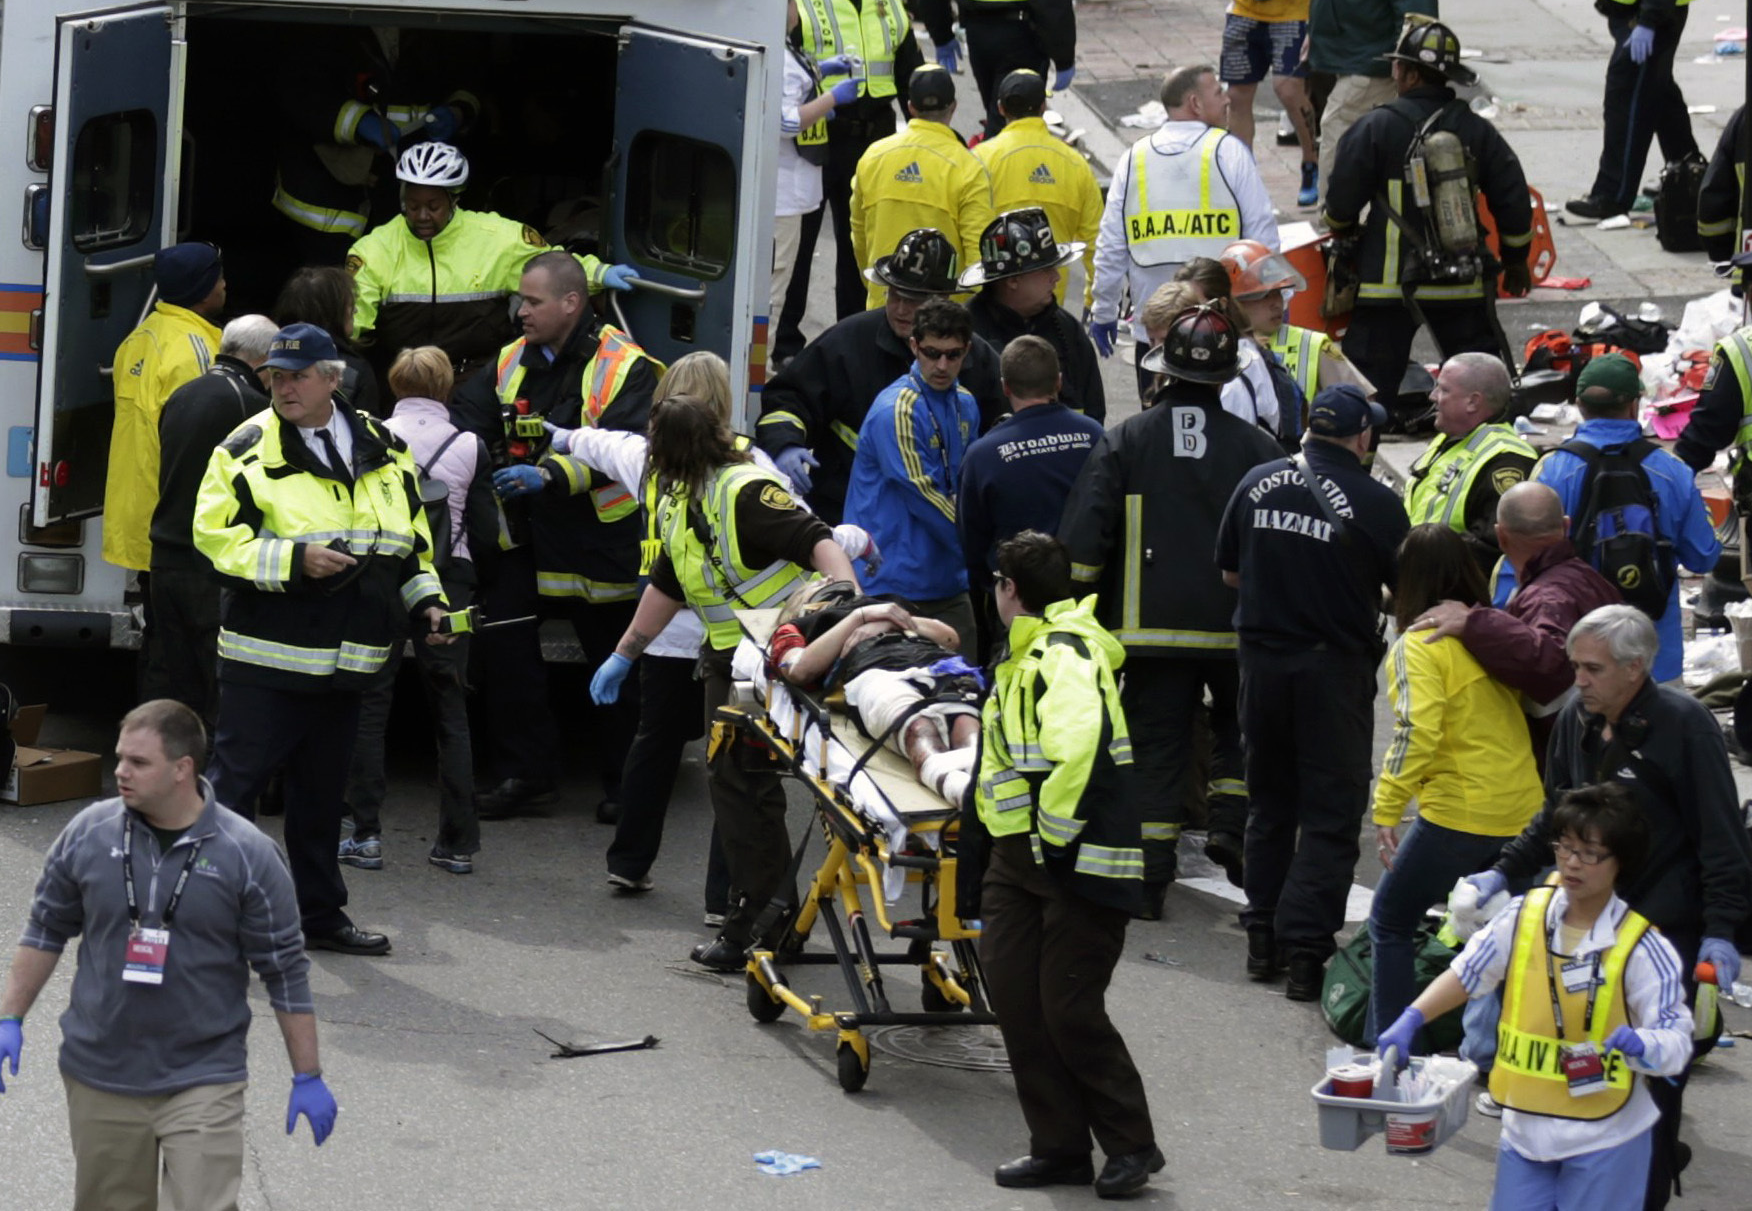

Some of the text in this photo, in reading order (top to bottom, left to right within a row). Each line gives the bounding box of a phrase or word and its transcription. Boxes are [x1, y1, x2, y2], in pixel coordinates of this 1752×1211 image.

[1037, 226, 1053, 249] 2
[1131, 213, 1231, 241] B.A.A./ATC
[997, 432, 1092, 459] Broadway
[1031, 446, 1058, 456] STATE
[1058, 443, 1070, 452] OF
[1248, 469, 1355, 521] BOSTO FIRE
[1253, 508, 1335, 543] HAZMAT
[1527, 1039, 1550, 1072] IV
